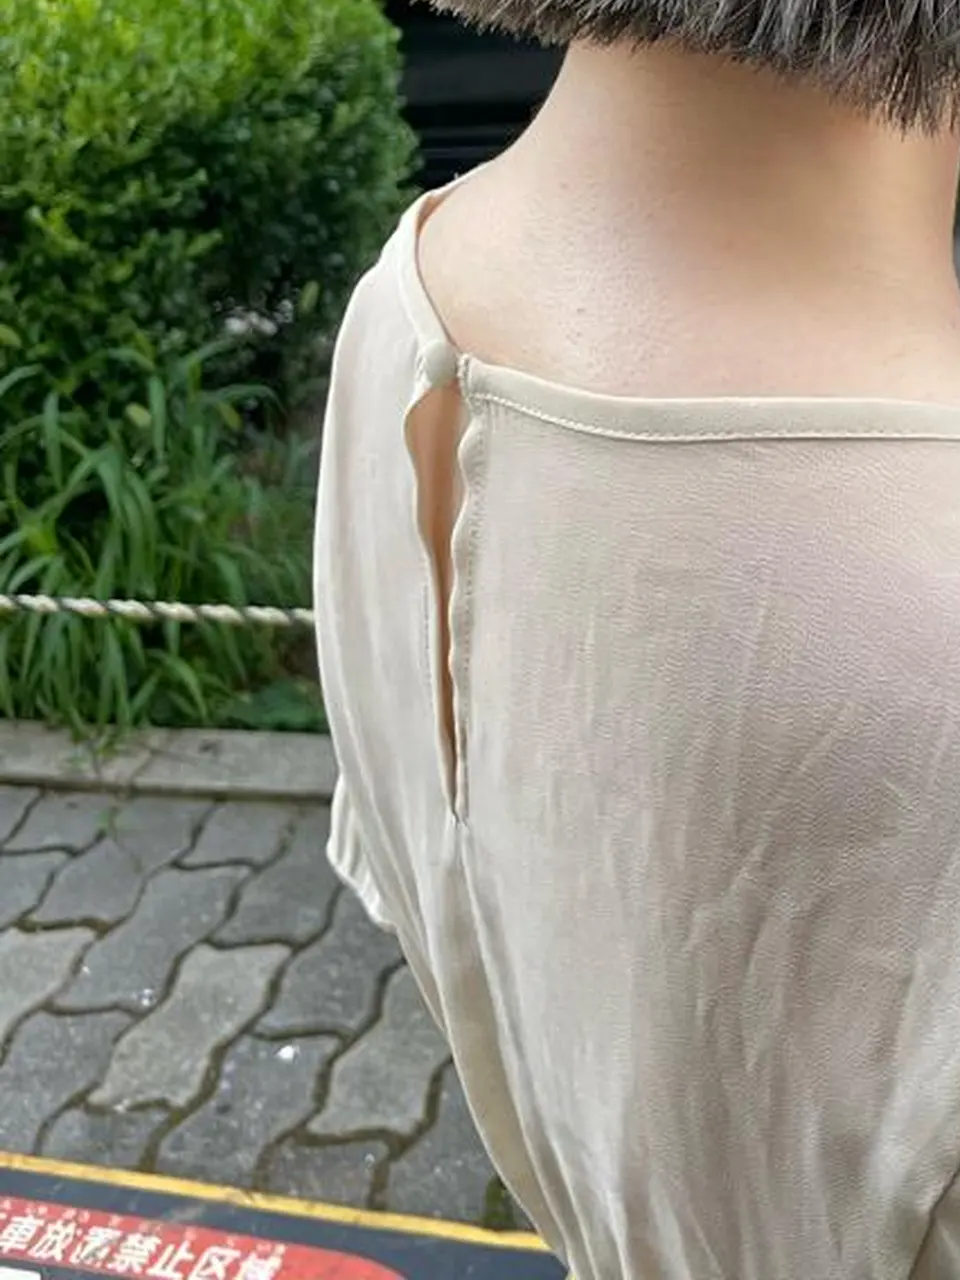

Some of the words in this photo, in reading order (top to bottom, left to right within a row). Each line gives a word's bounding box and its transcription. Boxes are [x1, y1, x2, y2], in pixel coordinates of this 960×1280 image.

[0, 1212, 284, 1280] 車放置禁止区域
